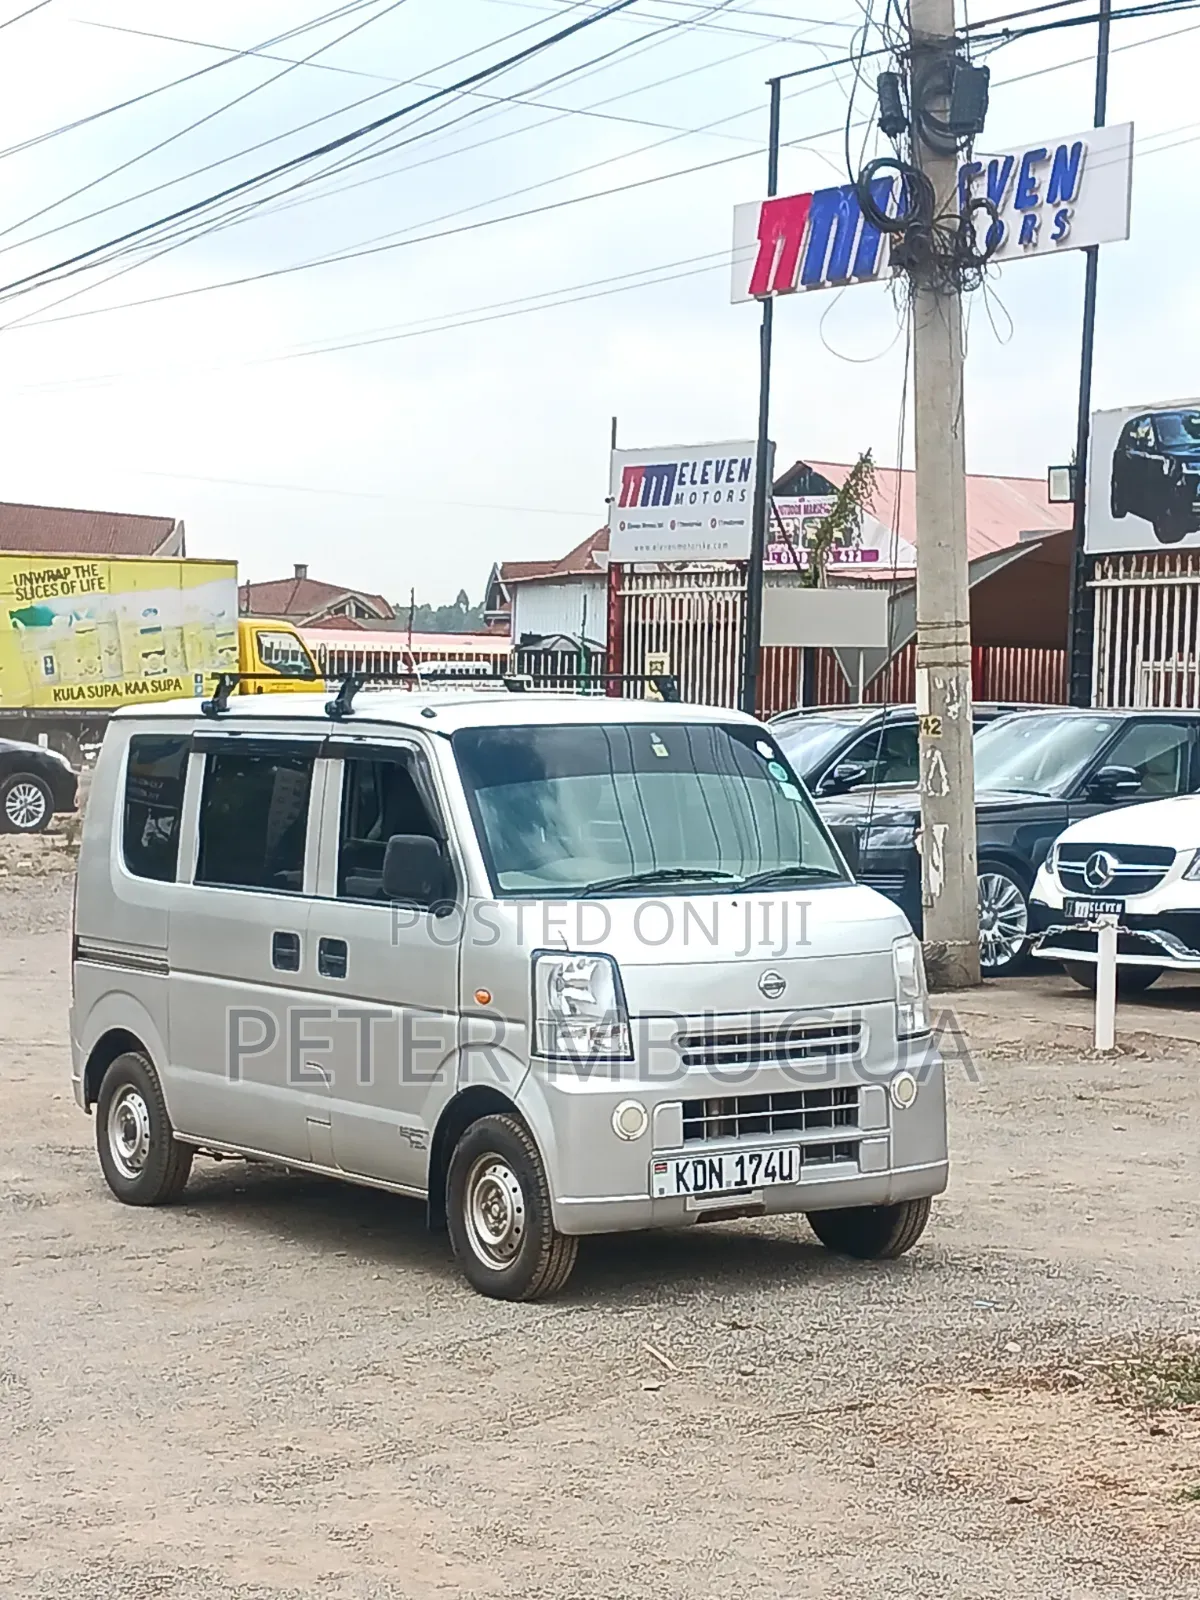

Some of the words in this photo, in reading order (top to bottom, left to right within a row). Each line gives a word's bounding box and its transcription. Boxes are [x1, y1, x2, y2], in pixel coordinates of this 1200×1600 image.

[678, 458, 752, 486] ELEVEN
[674, 489, 747, 505] MOTORS
[13, 567, 71, 586] UNWRAP
[73, 564, 99, 579] THE
[16, 583, 59, 601] SLICES
[61, 580, 77, 595] OF
[80, 577, 105, 592] LIFE
[53, 686, 86, 702] KULA
[87, 683, 122, 698] SUPA,
[125, 681, 149, 695] KAA
[151, 679, 183, 693] SUPA
[676, 1157, 723, 1193] KDN
[735, 1150, 793, 1187] 174U
